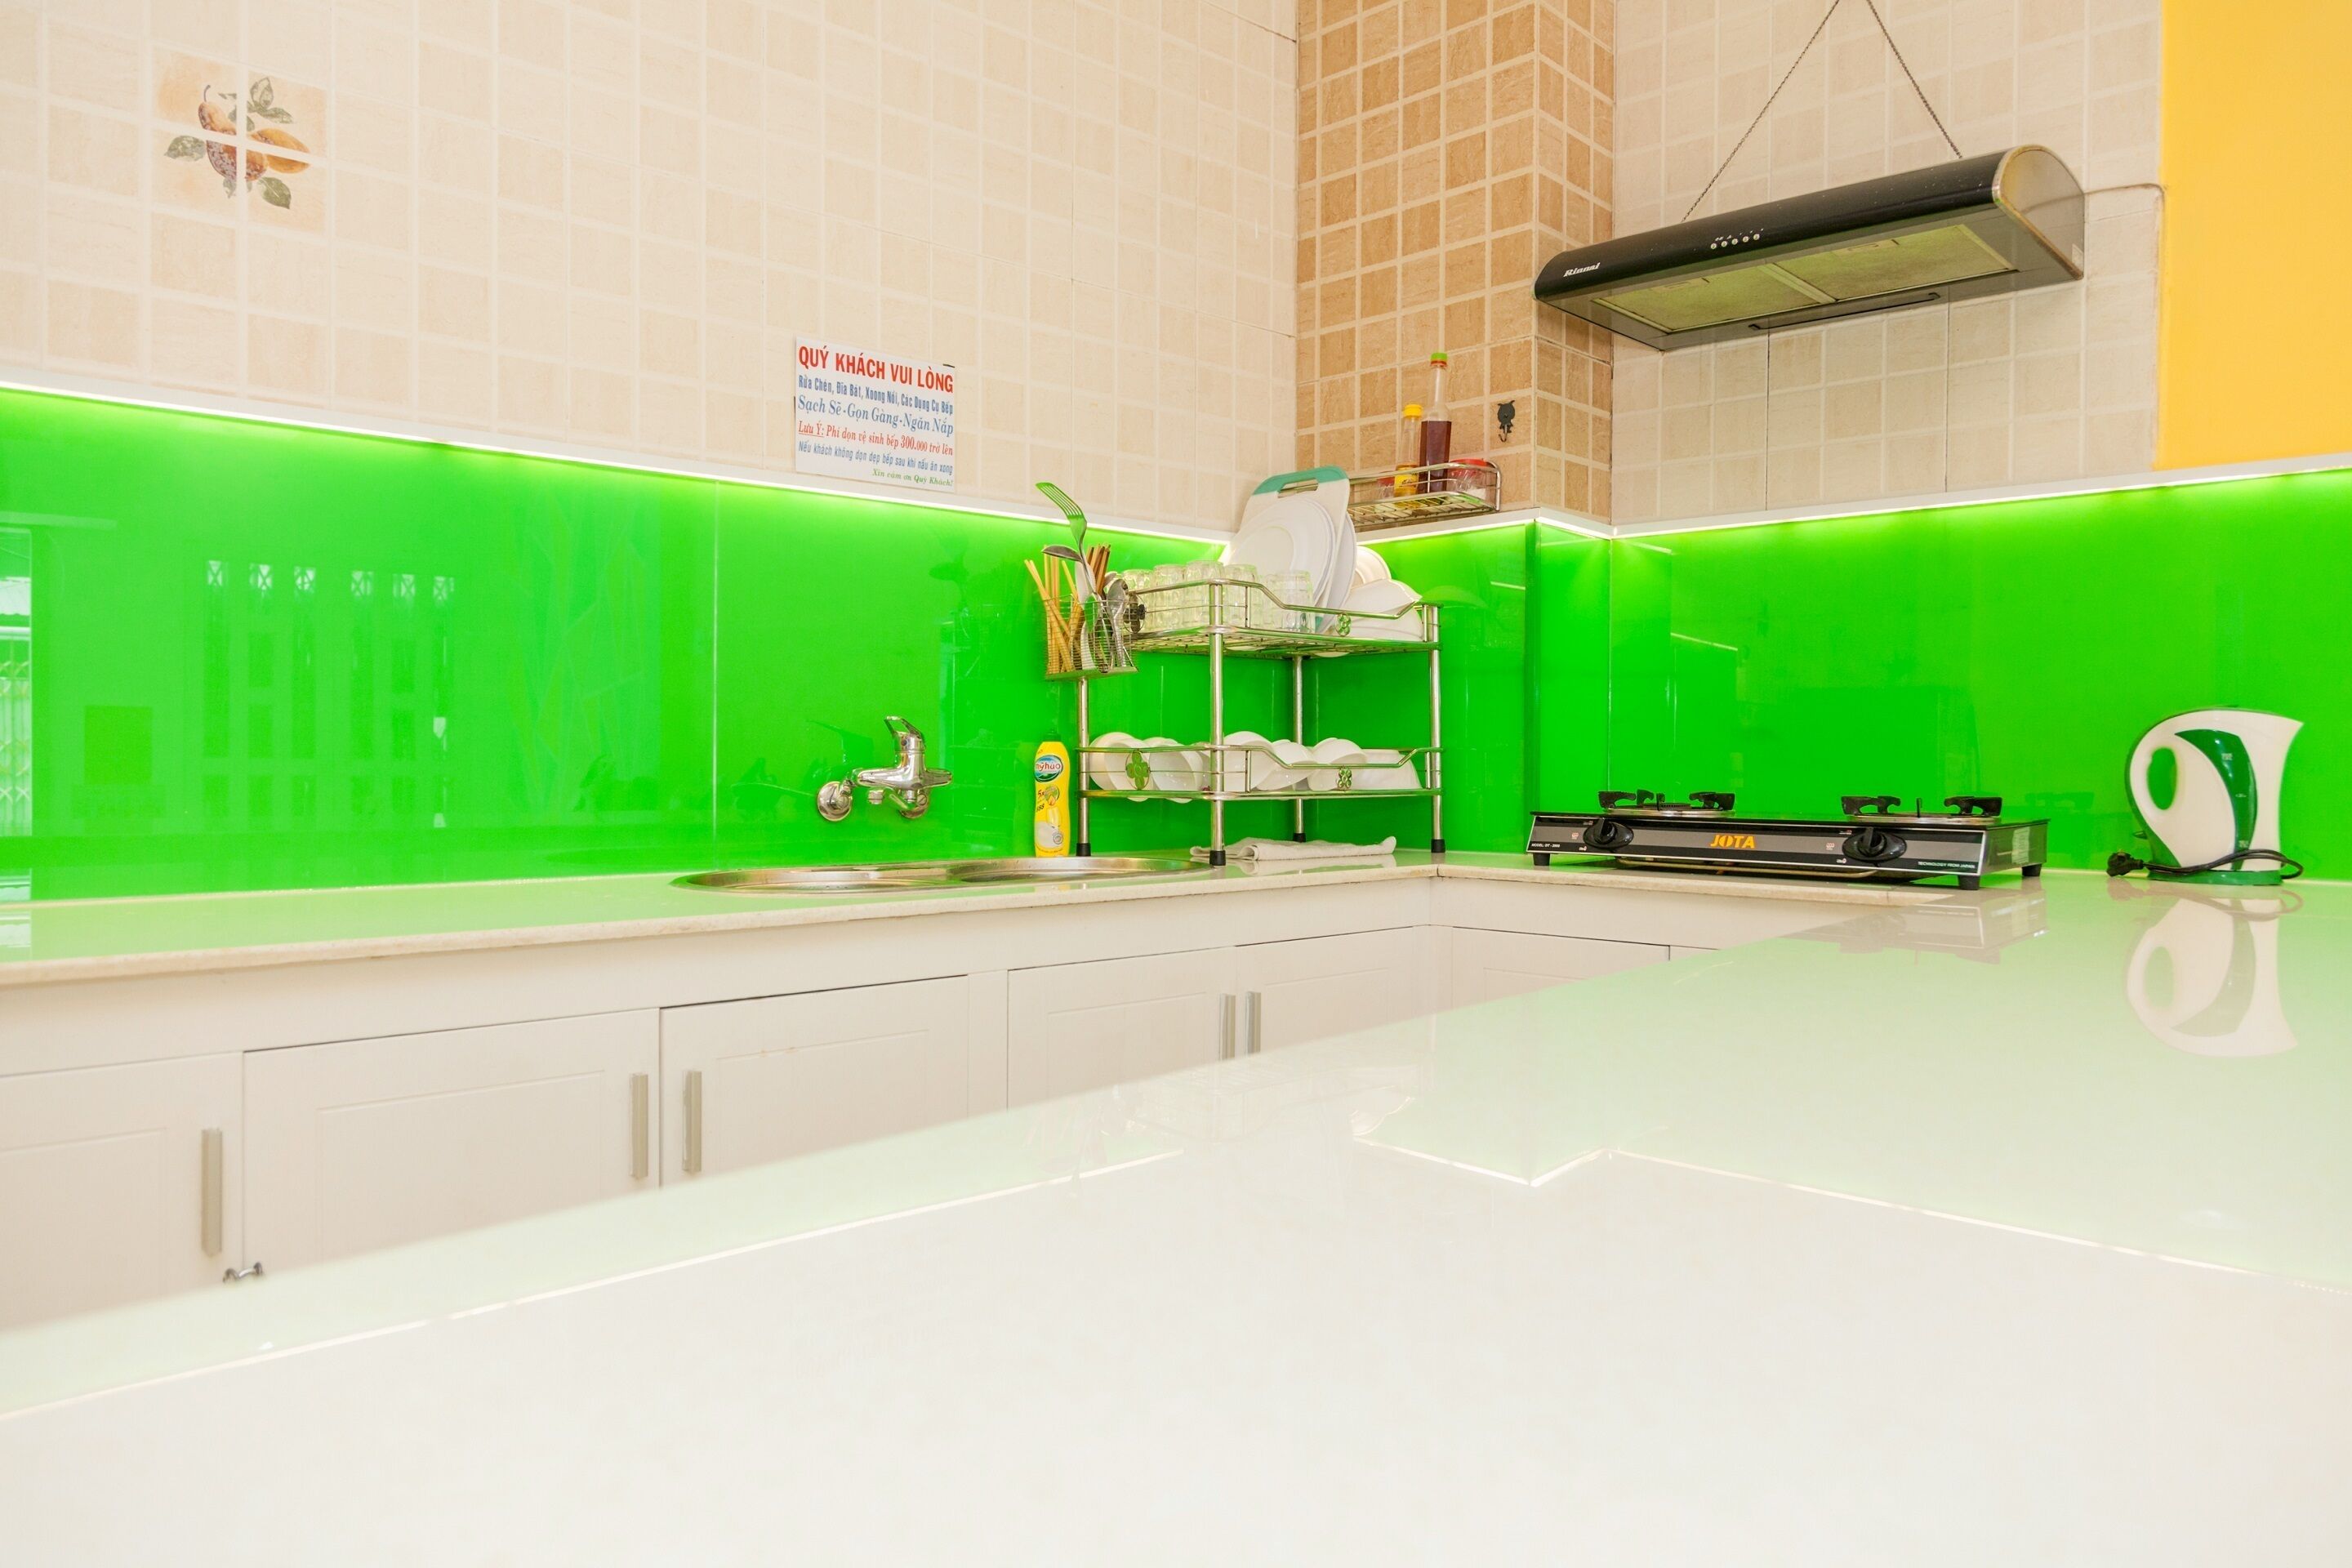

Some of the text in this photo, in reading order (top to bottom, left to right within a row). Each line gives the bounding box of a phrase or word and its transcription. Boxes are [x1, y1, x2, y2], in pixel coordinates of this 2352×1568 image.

[1563, 262, 1601, 278] Rinnai
[799, 345, 953, 394] QUÝ KHÁCH VUI LÒNG
[866, 386, 885, 404] Xoong
[798, 394, 826, 414] Sạch
[932, 417, 954, 438] Nắp
[798, 420, 814, 434] Lưu
[841, 427, 856, 442] dọn
[868, 431, 884, 445] sinh
[886, 434, 899, 449] bếp
[900, 434, 928, 452] 300.000
[799, 439, 812, 453] Nếu
[835, 446, 853, 461] không
[894, 457, 906, 467] sau
[906, 457, 916, 468] khi
[939, 464, 953, 476] xong
[872, 468, 885, 478] Xin
[1710, 835, 1755, 849] JOTA
